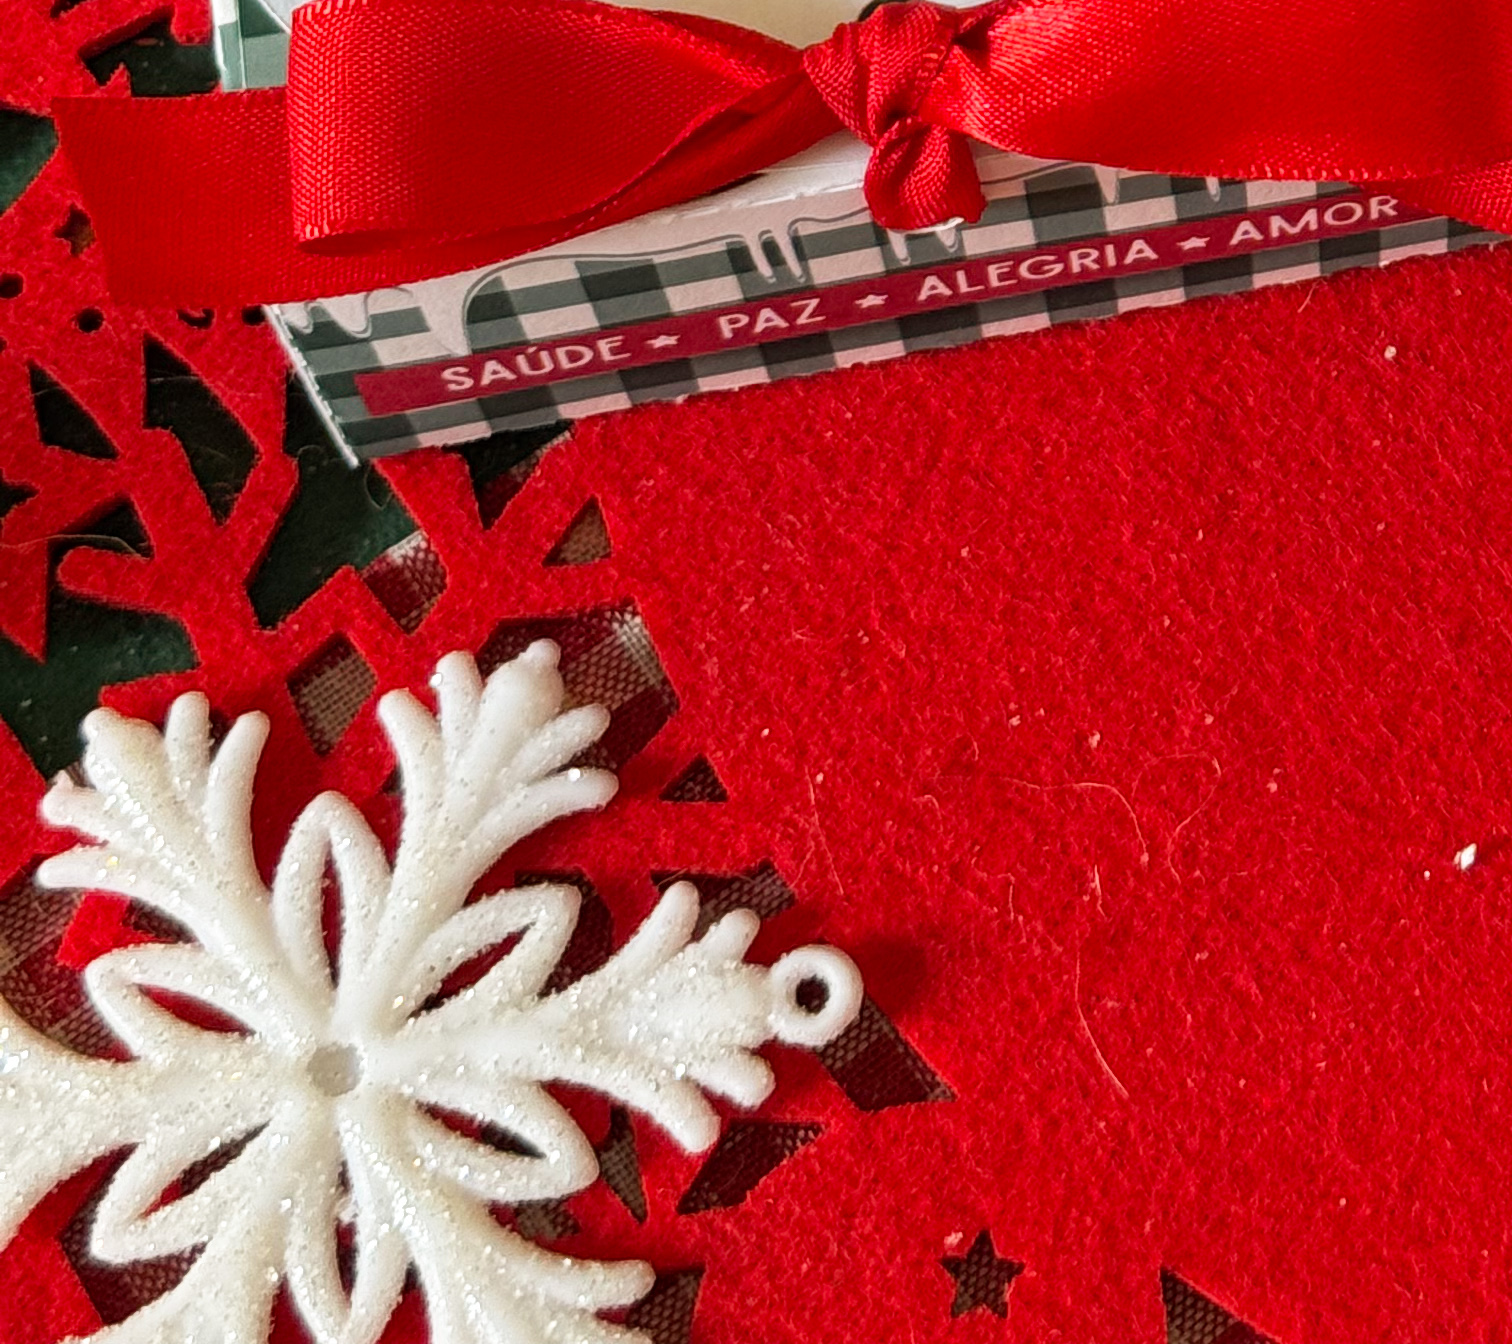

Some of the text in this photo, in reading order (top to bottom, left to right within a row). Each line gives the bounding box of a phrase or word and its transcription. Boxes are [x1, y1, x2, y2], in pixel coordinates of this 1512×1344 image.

[440, 194, 1400, 393] SAÚDE PAZ ALEGRIA AMOR
